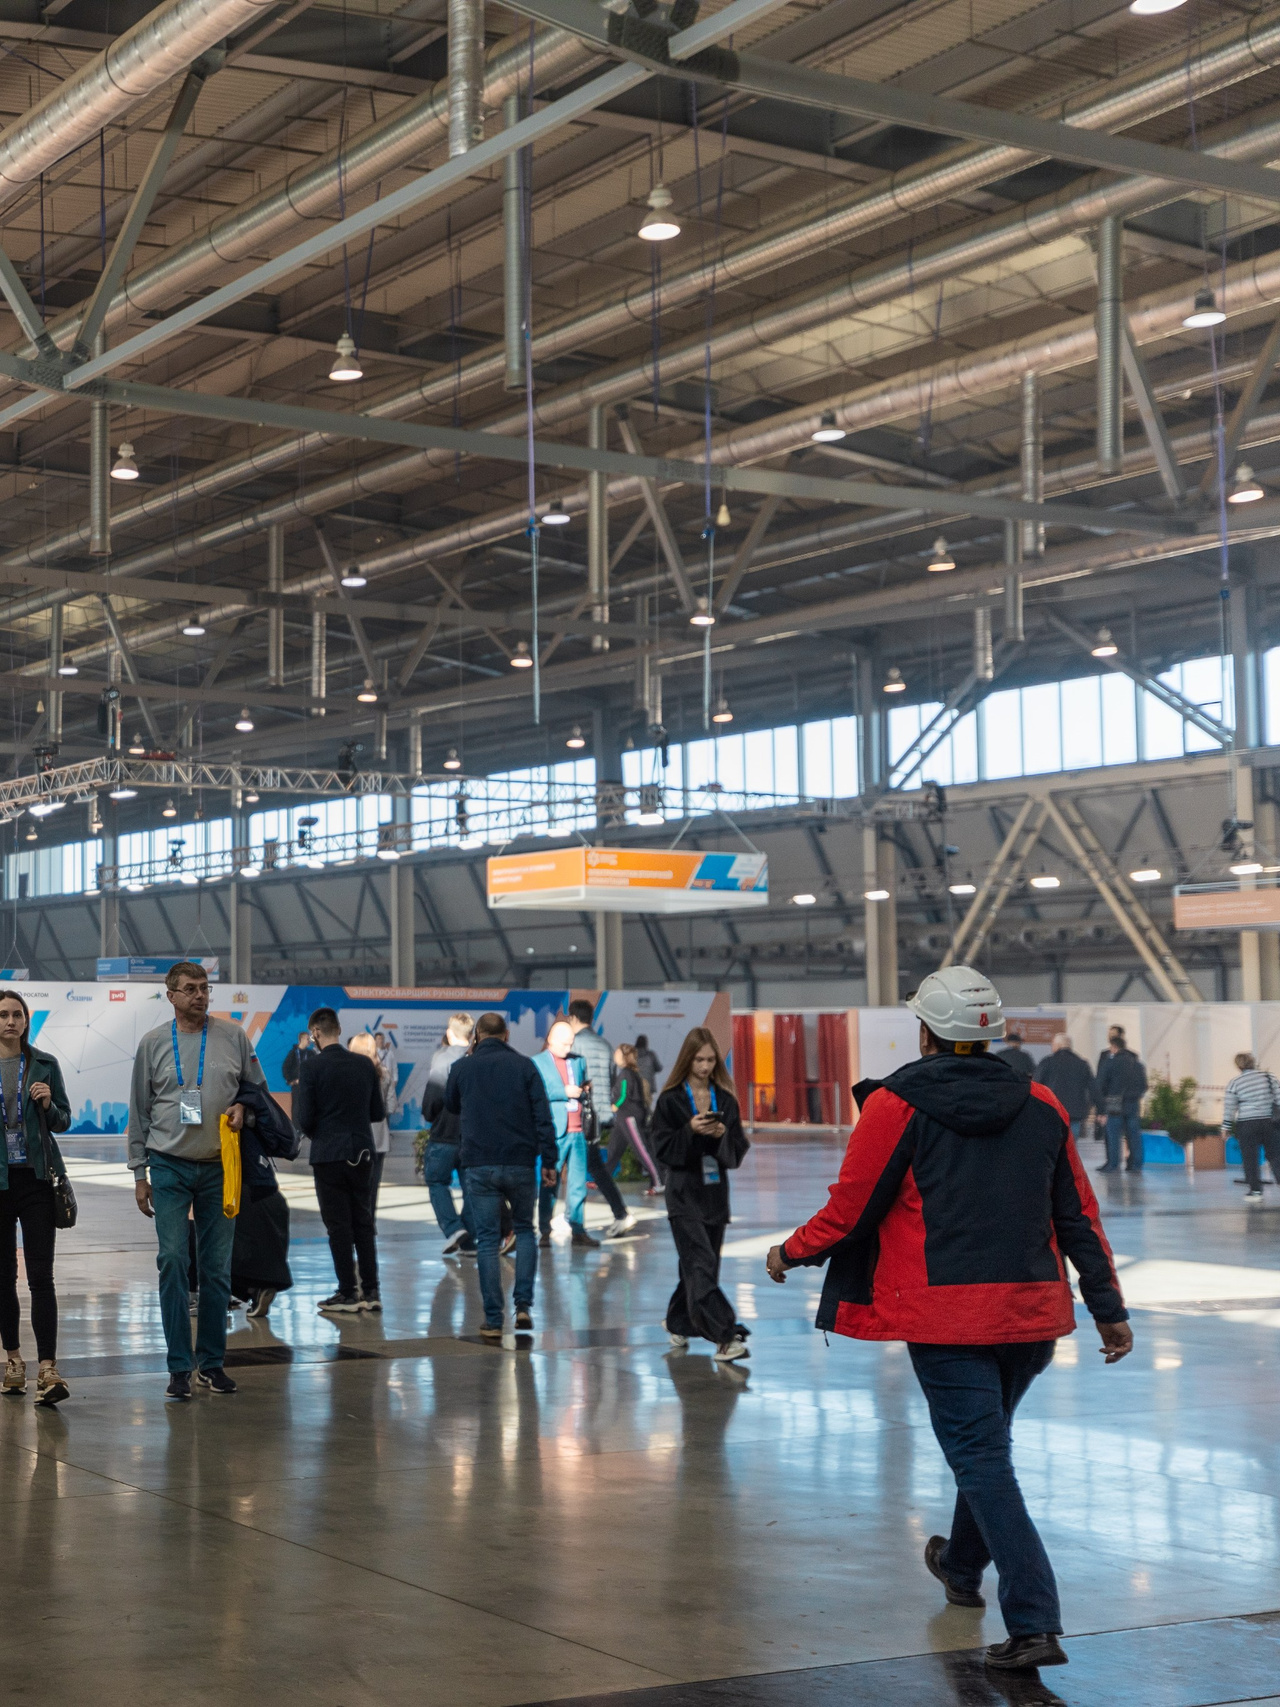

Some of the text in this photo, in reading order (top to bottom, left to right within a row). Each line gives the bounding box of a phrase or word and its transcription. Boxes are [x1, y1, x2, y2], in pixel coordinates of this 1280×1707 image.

[353, 988, 499, 998] ЭЛЕКТРОСВАРЩИК РУЧНОЙ СВАРКИ
